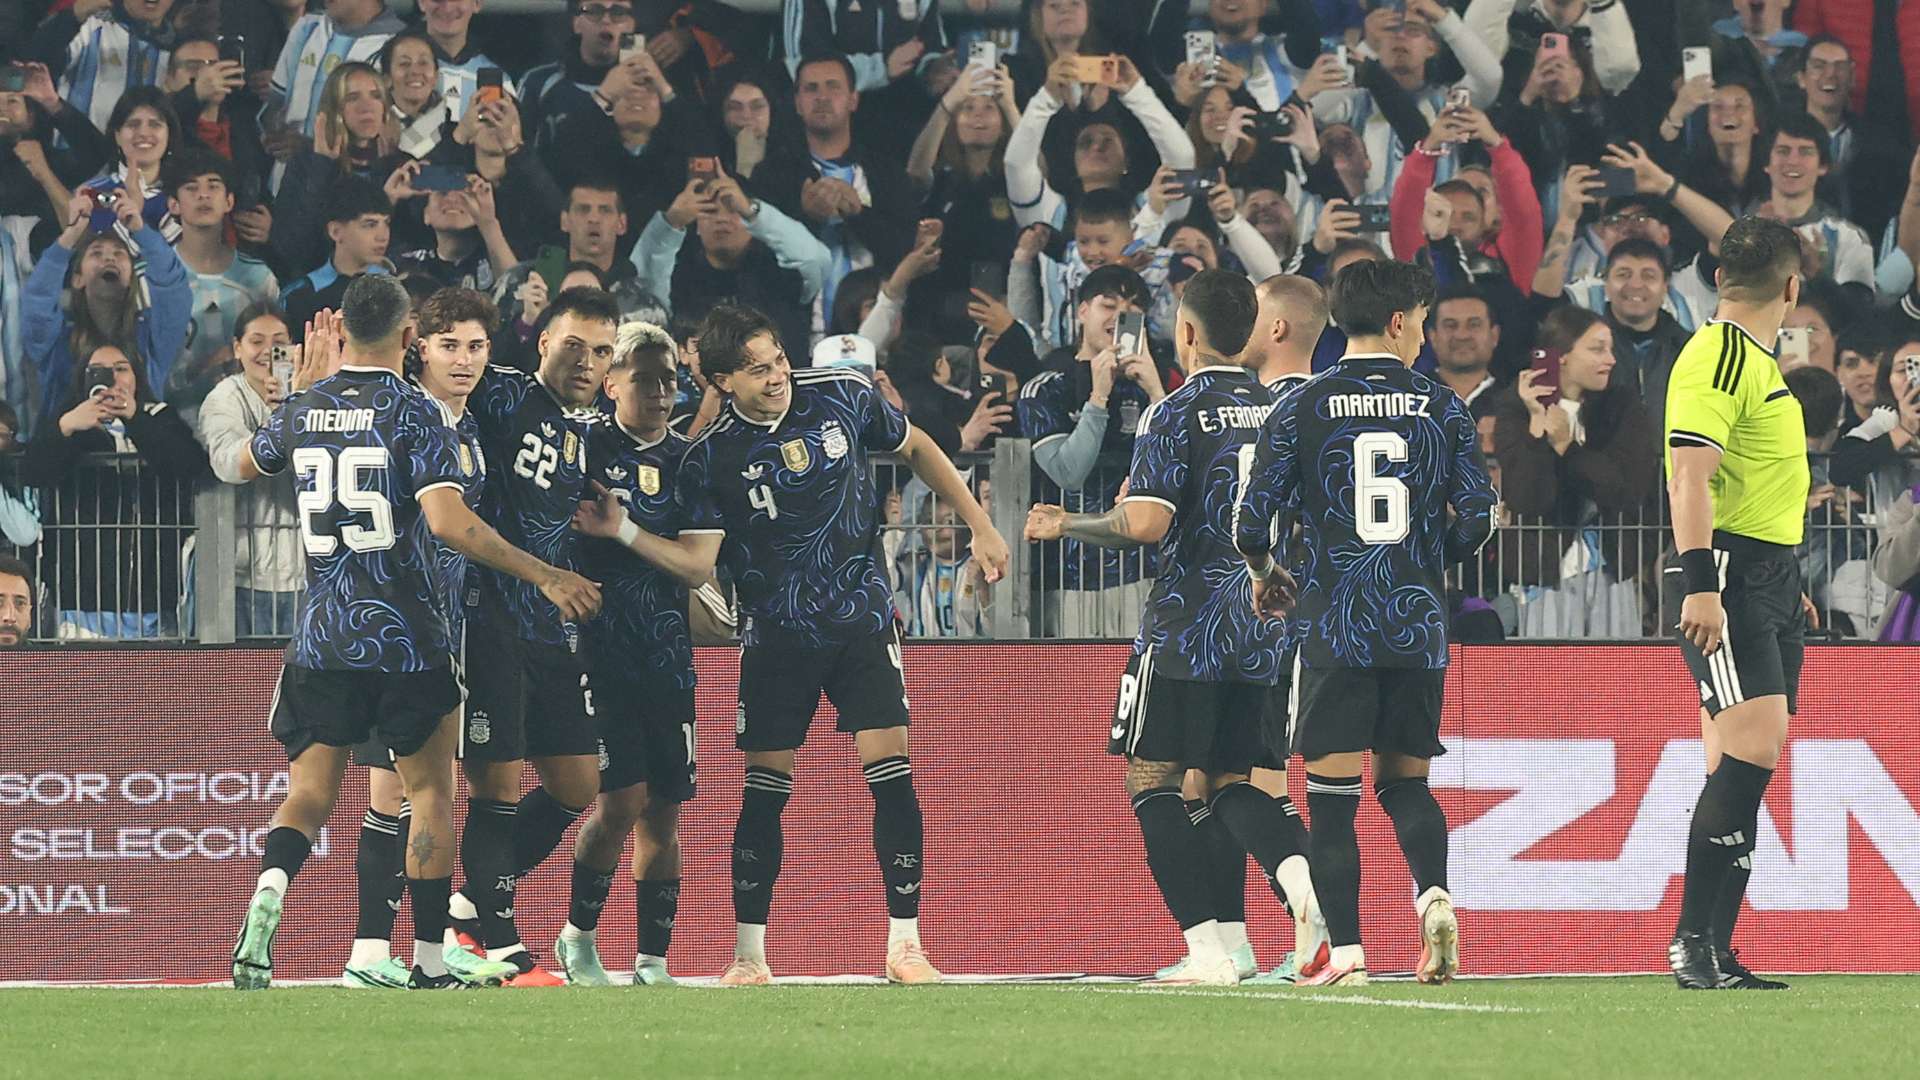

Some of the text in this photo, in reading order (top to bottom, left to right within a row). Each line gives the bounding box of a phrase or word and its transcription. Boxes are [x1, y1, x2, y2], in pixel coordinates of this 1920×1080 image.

[305, 408, 374, 432] MEDINA
[1328, 393, 1431, 418] MARTINEZ
[514, 432, 559, 490] 22
[292, 446, 396, 557] 25
[748, 484, 778, 521] 4
[1353, 432, 1410, 545] 6
